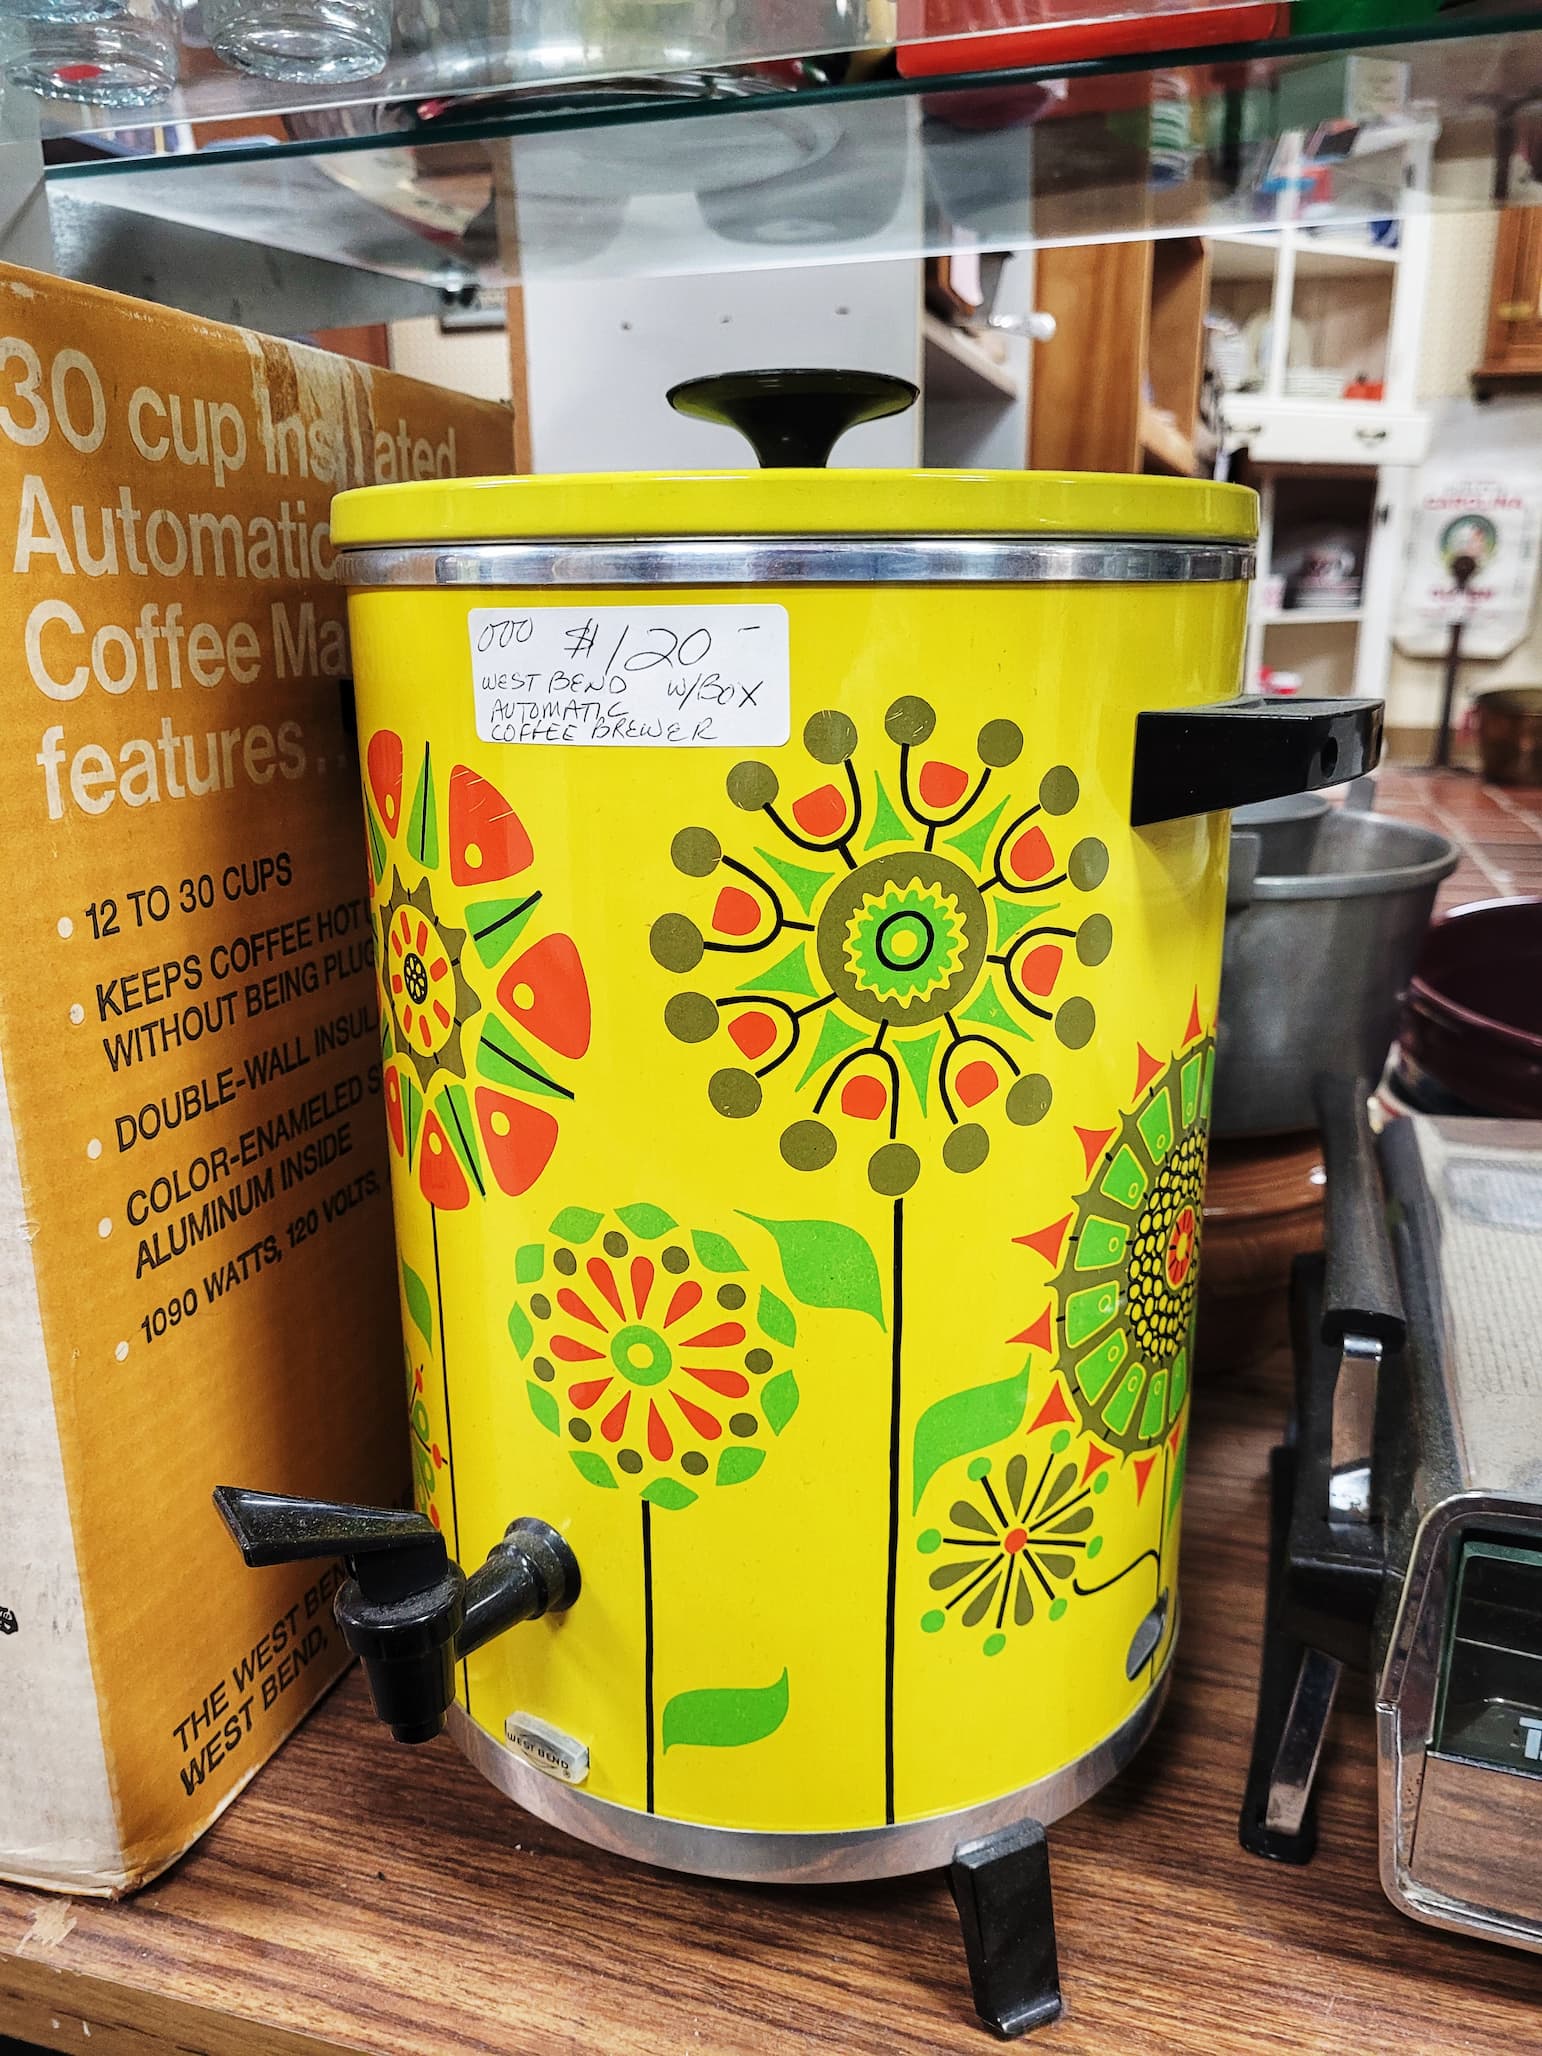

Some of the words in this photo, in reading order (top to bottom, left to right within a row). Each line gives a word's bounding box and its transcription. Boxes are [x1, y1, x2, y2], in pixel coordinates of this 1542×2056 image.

[0, 337, 105, 454] 30
[128, 386, 247, 487] cup
[13, 474, 340, 581] Automatic
[24, 600, 260, 702] Coffee
[271, 602, 347, 680] Ma
[482, 673, 543, 692] WEST
[548, 670, 628, 695] BEND
[490, 698, 630, 724] AUTOMATIC
[491, 721, 579, 742] COFFEE
[591, 717, 718, 742] BREWER
[86, 899, 120, 939] 12
[127, 885, 170, 926] TO
[179, 872, 214, 912] 30
[222, 852, 292, 904] CUPS
[96, 954, 202, 1022] KEEPS
[210, 916, 312, 980] COFFEE
[317, 900, 361, 943] HOT
[103, 991, 216, 1072] WITHOUT
[245, 962, 320, 1018] BEING
[115, 1036, 310, 1153] DOUBLE-WALL
[127, 1076, 362, 1226] COLOR-ENAMELED
[136, 1168, 275, 1279] ALUMINUM
[280, 1122, 353, 1191] INSIDE
[141, 1288, 198, 1343] 1090
[203, 1234, 283, 1304] WATTS,
[285, 1208, 319, 1248] 120
[173, 1680, 228, 1753] THE
[232, 1603, 299, 1692] WEST
[179, 1696, 254, 1797] WEST
[261, 1624, 328, 1711] BEND,
[507, 1731, 534, 1752] WEST
[538, 1748, 569, 1769] BEND
